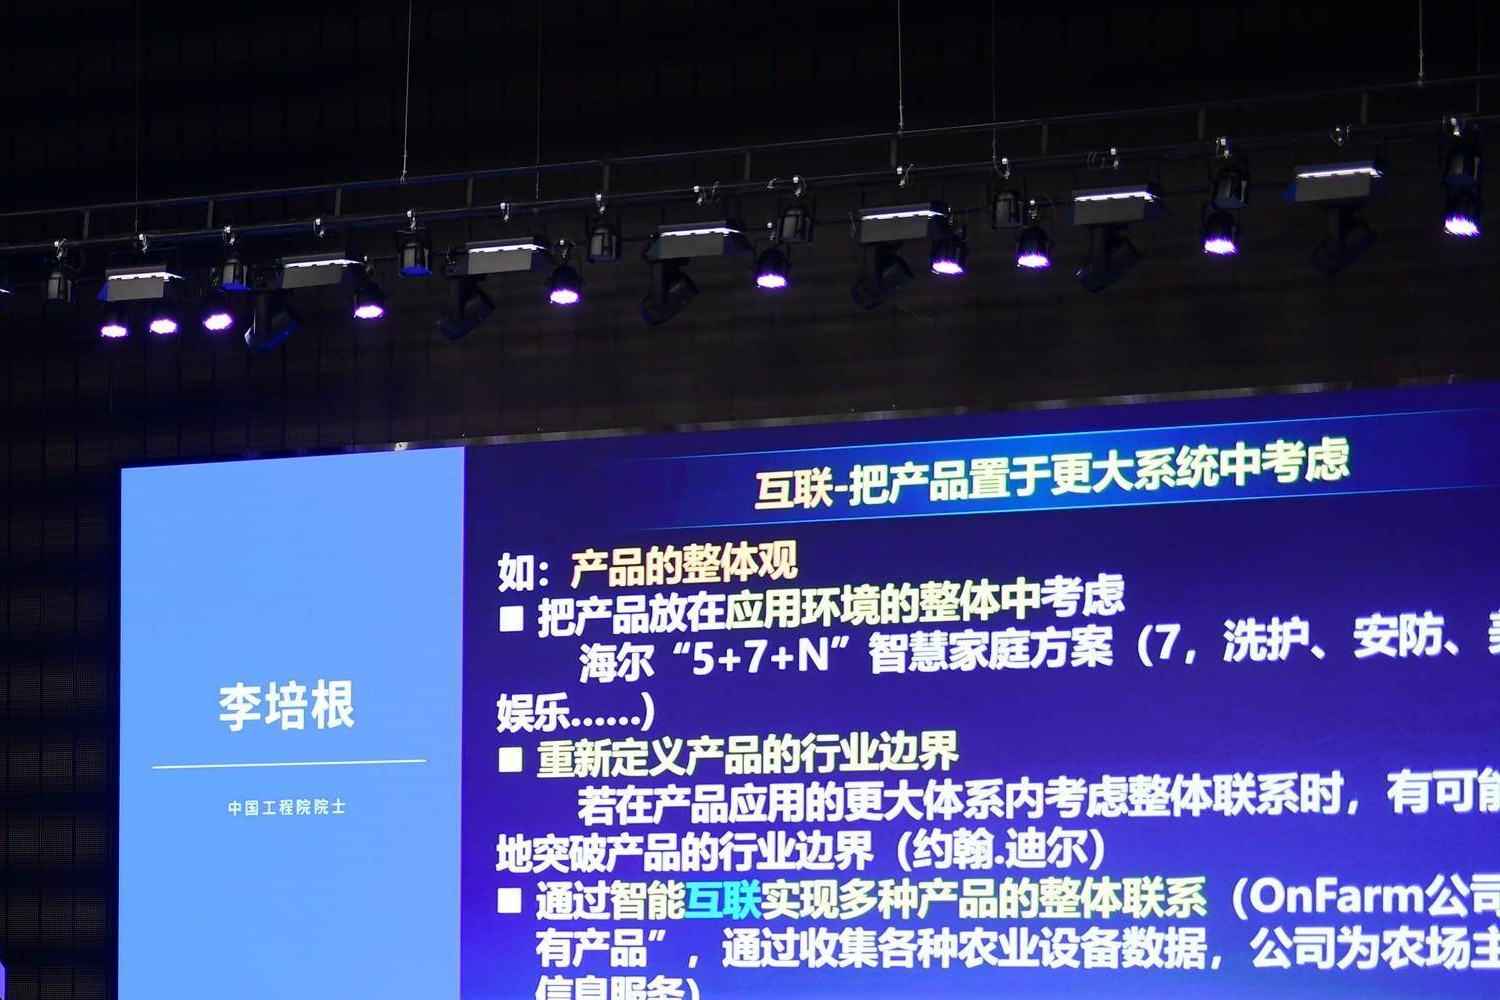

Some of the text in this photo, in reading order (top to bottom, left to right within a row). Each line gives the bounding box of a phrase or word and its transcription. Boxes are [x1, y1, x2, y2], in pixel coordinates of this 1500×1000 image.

[754, 437, 1350, 510] 互联-把产品置于更大系统中考虑
[497, 540, 799, 592] 如：产品的整体观
[538, 573, 1126, 638] 把产品放在应用环境的整体中考虑
[219, 679, 355, 732] 李培根
[537, 729, 959, 778] 重新定义产品的行业边界
[228, 797, 347, 816] 中国工程院院士
